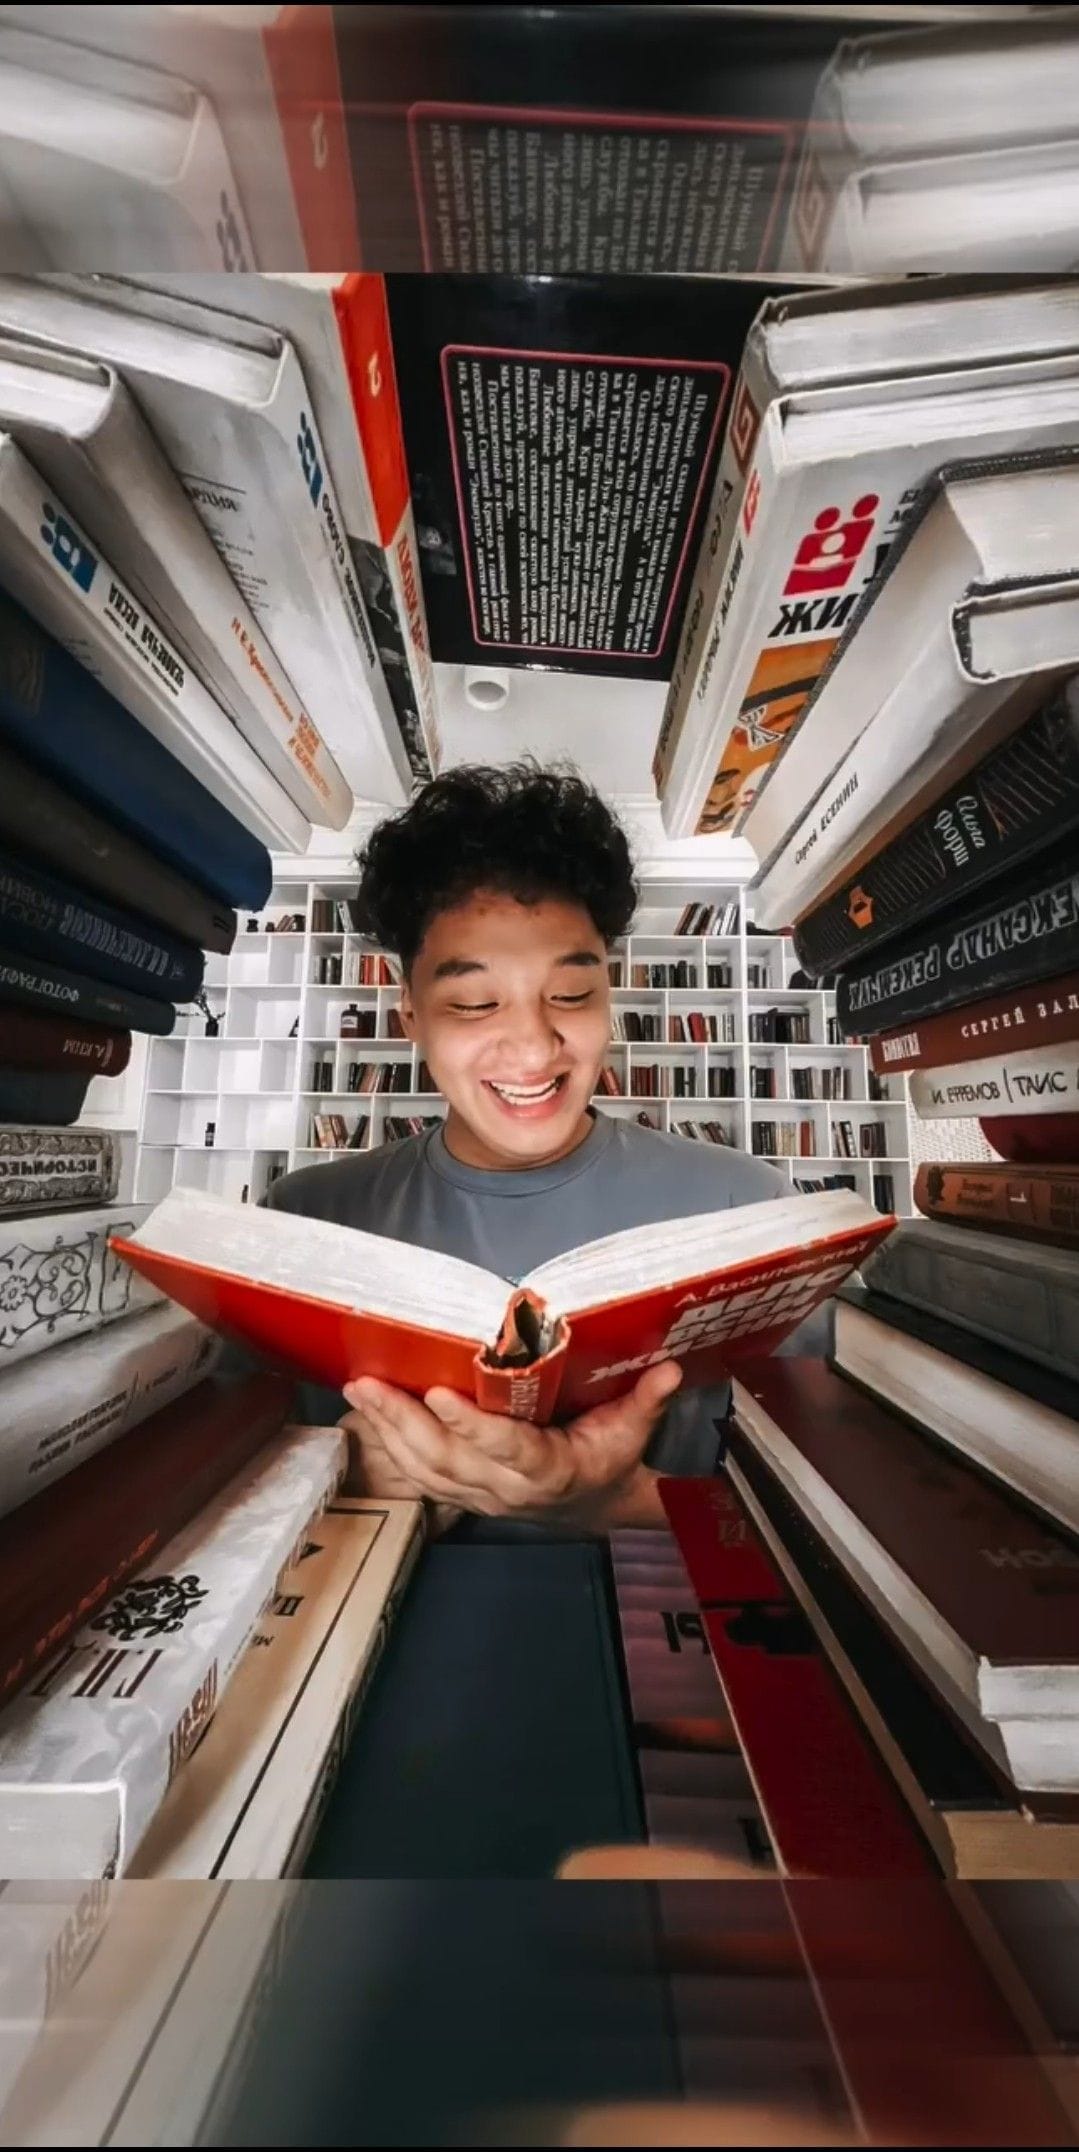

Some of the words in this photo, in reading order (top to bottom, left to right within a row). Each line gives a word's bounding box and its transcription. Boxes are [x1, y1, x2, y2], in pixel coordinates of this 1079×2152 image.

[457, 361, 467, 385] ня,
[471, 362, 485, 435] нозвездой
[500, 364, 509, 388] мы
[514, 365, 524, 434] пожалуй,
[556, 368, 565, 404] ного
[569, 370, 580, 411] лишь
[582, 370, 597, 431] службы.
[595, 371, 608, 428] отозван
[612, 372, 622, 389] ва
[652, 375, 666, 409] лась
[664, 375, 680, 417] ского
[487, 379, 502, 479] Поставленный
[529, 367, 539, 439] Бангкоке,
[542, 383, 553, 457] Любовные
[619, 373, 637, 453] скрывается
[109, 581, 138, 627] ВЕСНА
[768, 594, 860, 638] ЖИ
[820, 774, 860, 832] ЕСЕНИН
[958, 796, 985, 849] Ольга
[935, 809, 968, 866] Форш
[961, 1005, 1026, 1039] СЕРГЕЙ
[946, 1079, 1000, 1103] ЕФРЕМОВ
[1012, 1070, 1067, 1097] ТАИС
[670, 1264, 855, 1331] ДЕЛО
[585, 1302, 816, 1384] ЖИЗНИ
